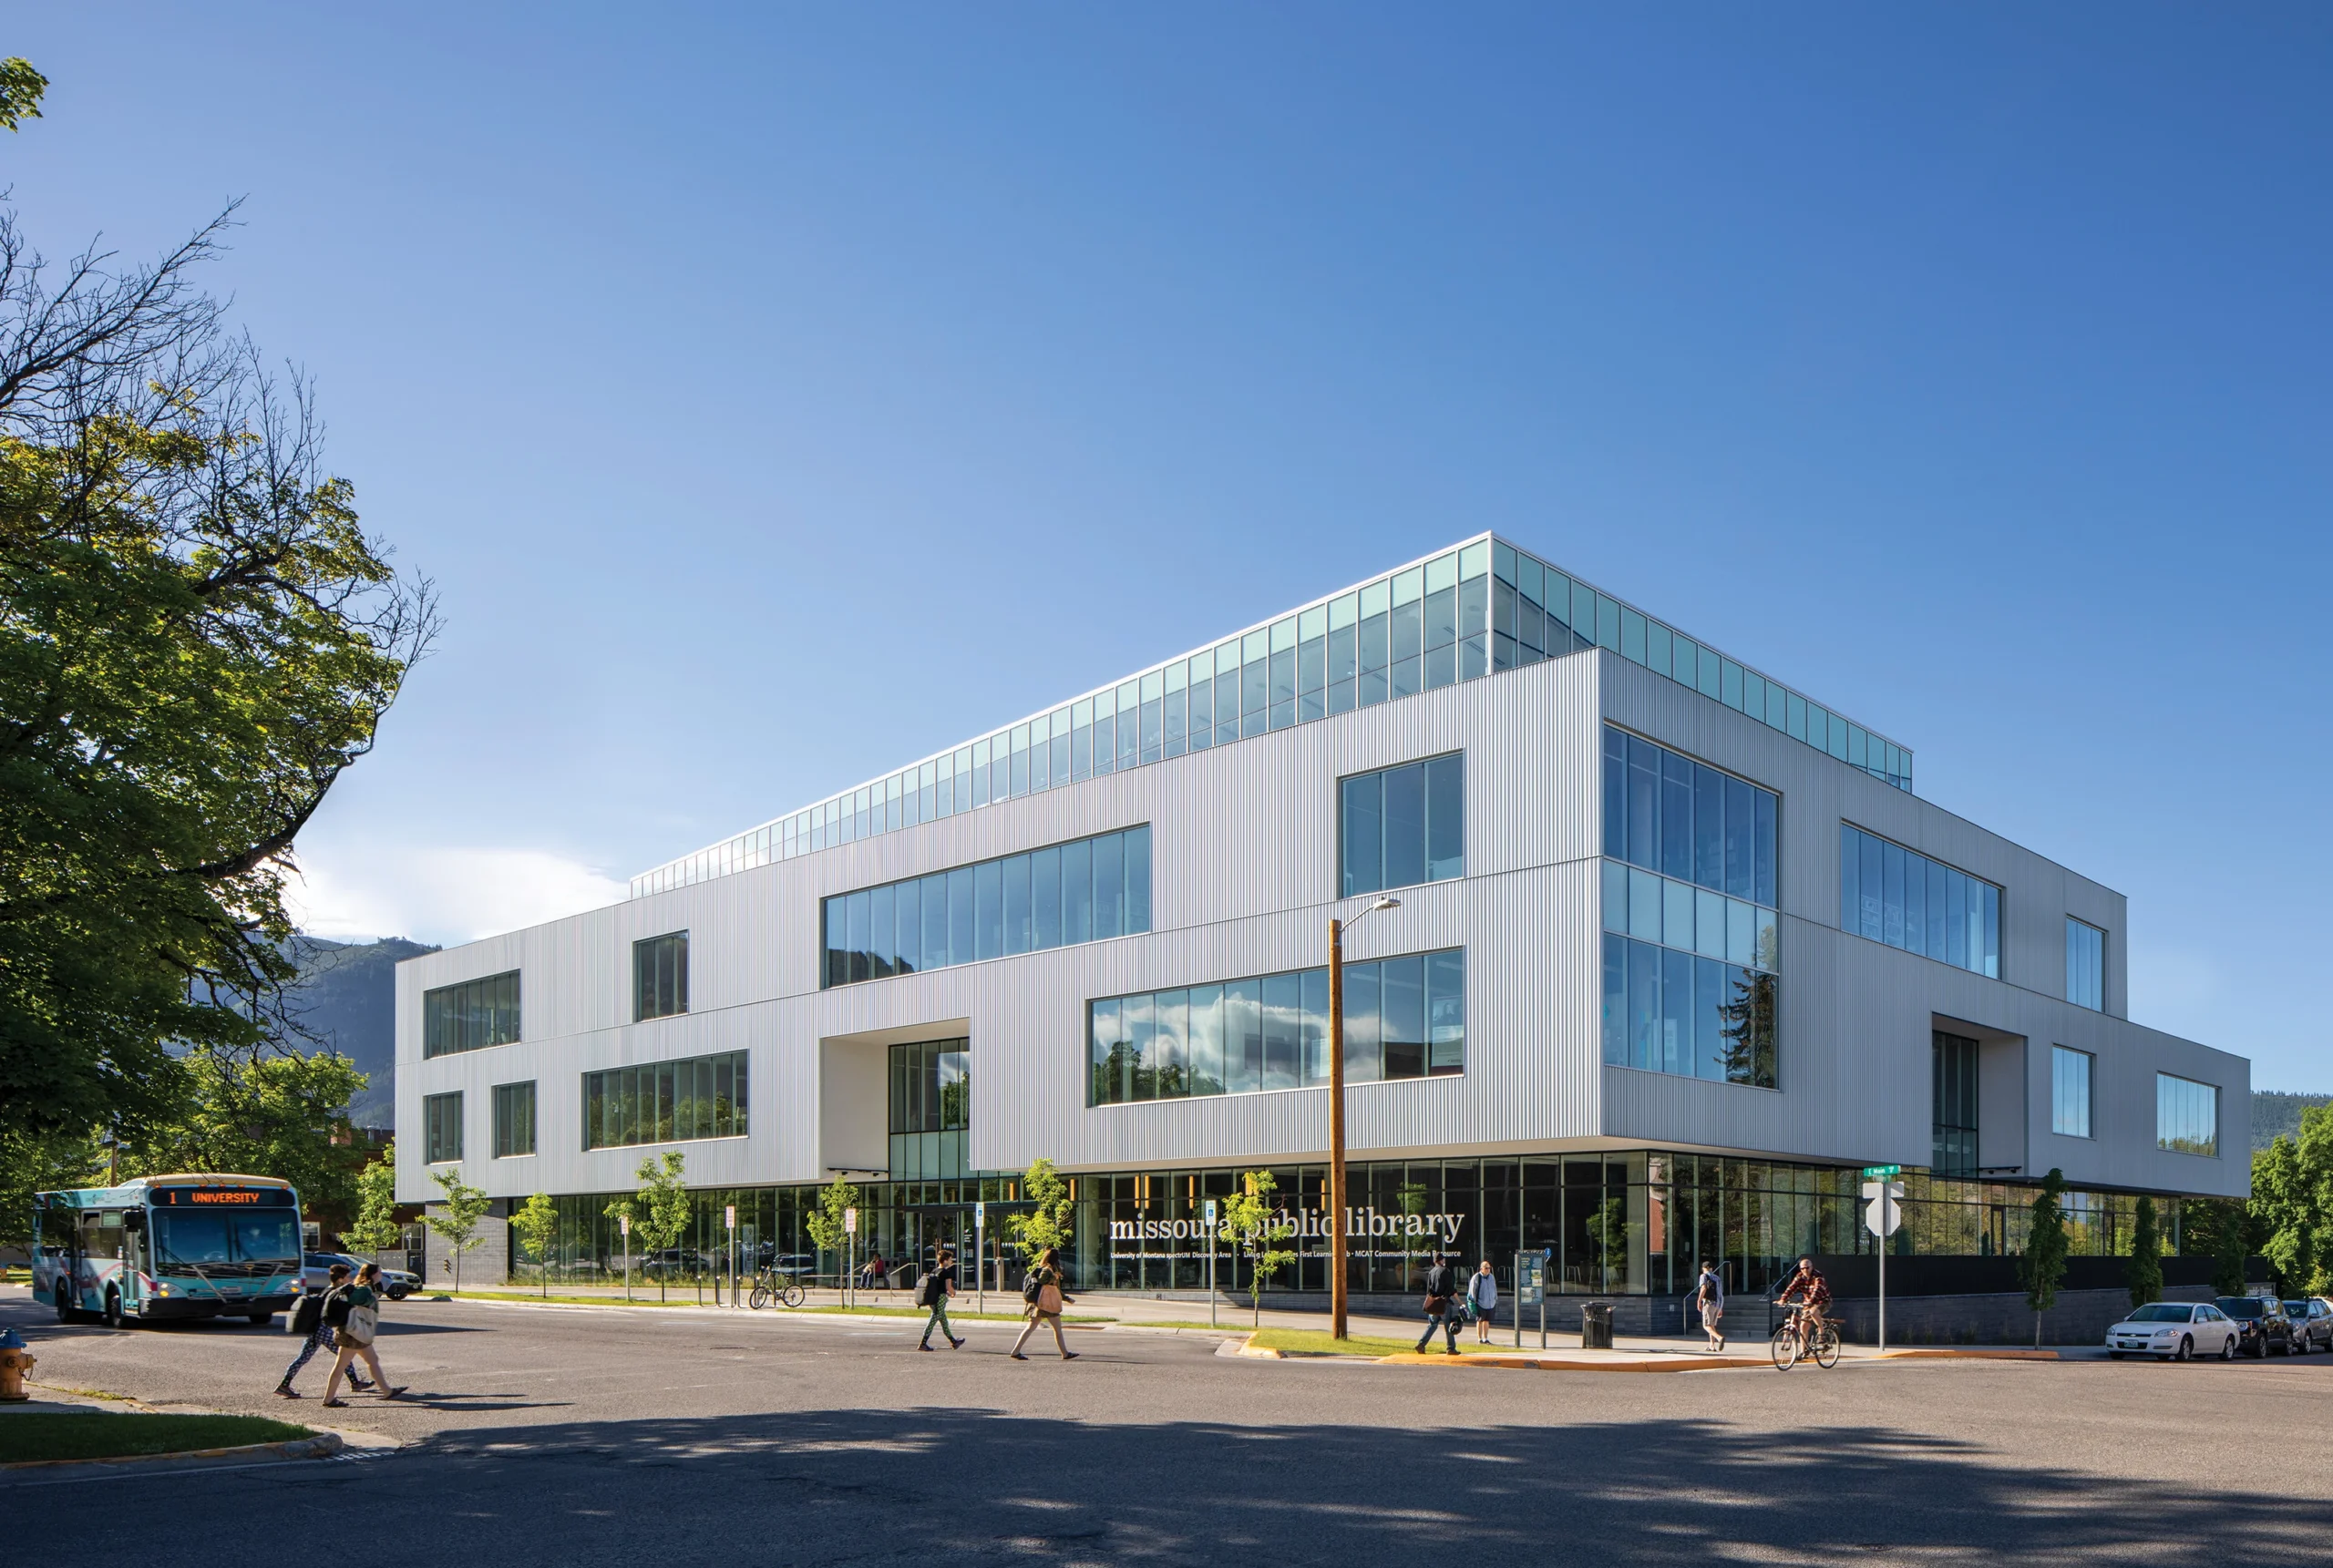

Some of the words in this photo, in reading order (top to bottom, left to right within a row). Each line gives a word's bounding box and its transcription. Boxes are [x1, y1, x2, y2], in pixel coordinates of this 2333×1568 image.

[169, 1192, 177, 1204] 1
[191, 1193, 260, 1203] UNIVERSITY
[1110, 1213, 1233, 1240] missoua
[1345, 1206, 1465, 1244] library
[1110, 1252, 1136, 1260] University
[1374, 1250, 1410, 1258] Community
